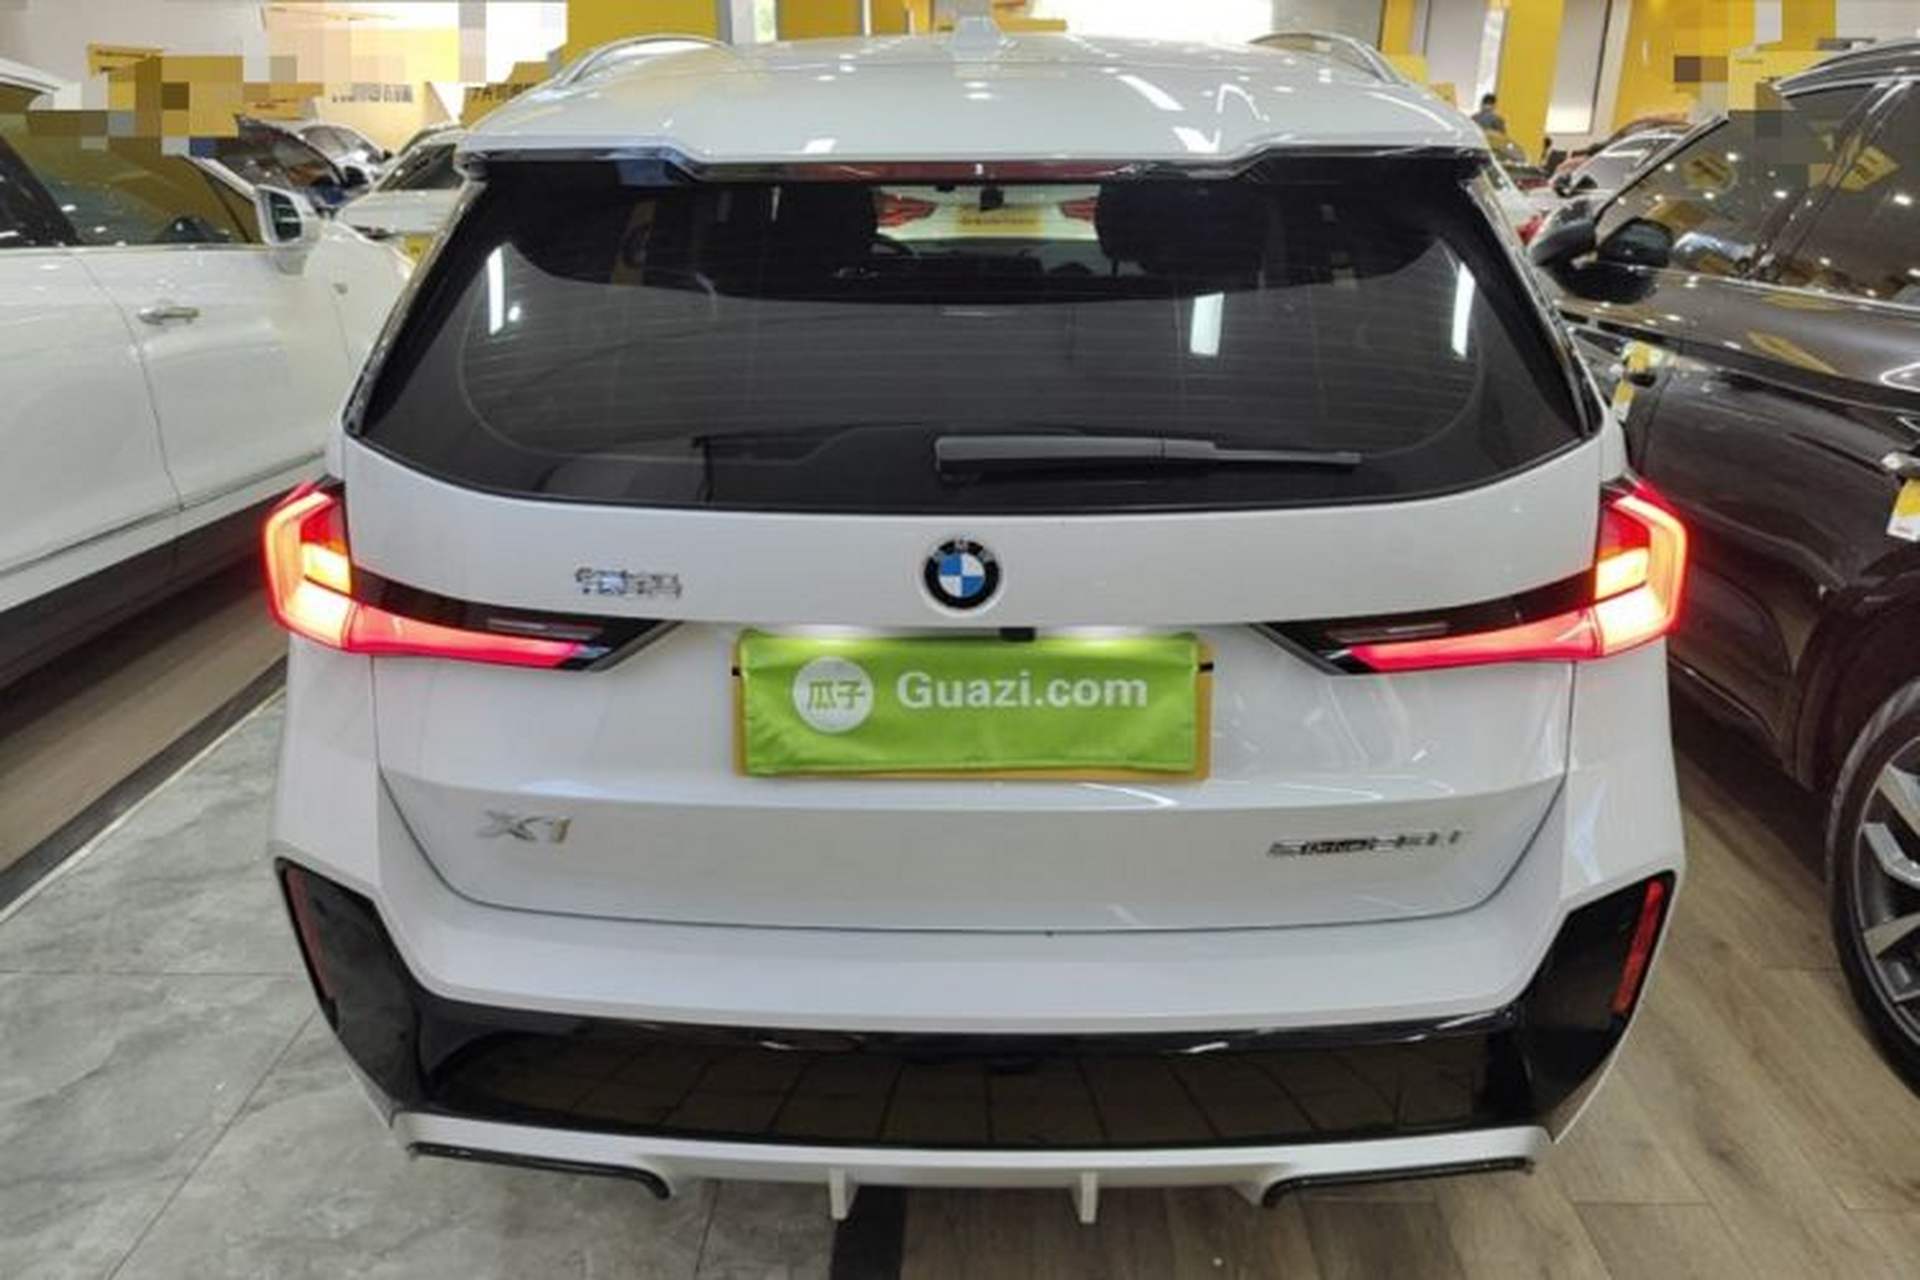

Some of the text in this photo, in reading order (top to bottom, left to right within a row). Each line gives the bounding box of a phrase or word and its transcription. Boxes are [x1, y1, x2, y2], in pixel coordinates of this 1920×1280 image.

[807, 678, 865, 710] 瓜子
[897, 670, 1148, 709] Guazi.com
[477, 809, 572, 843] X1
